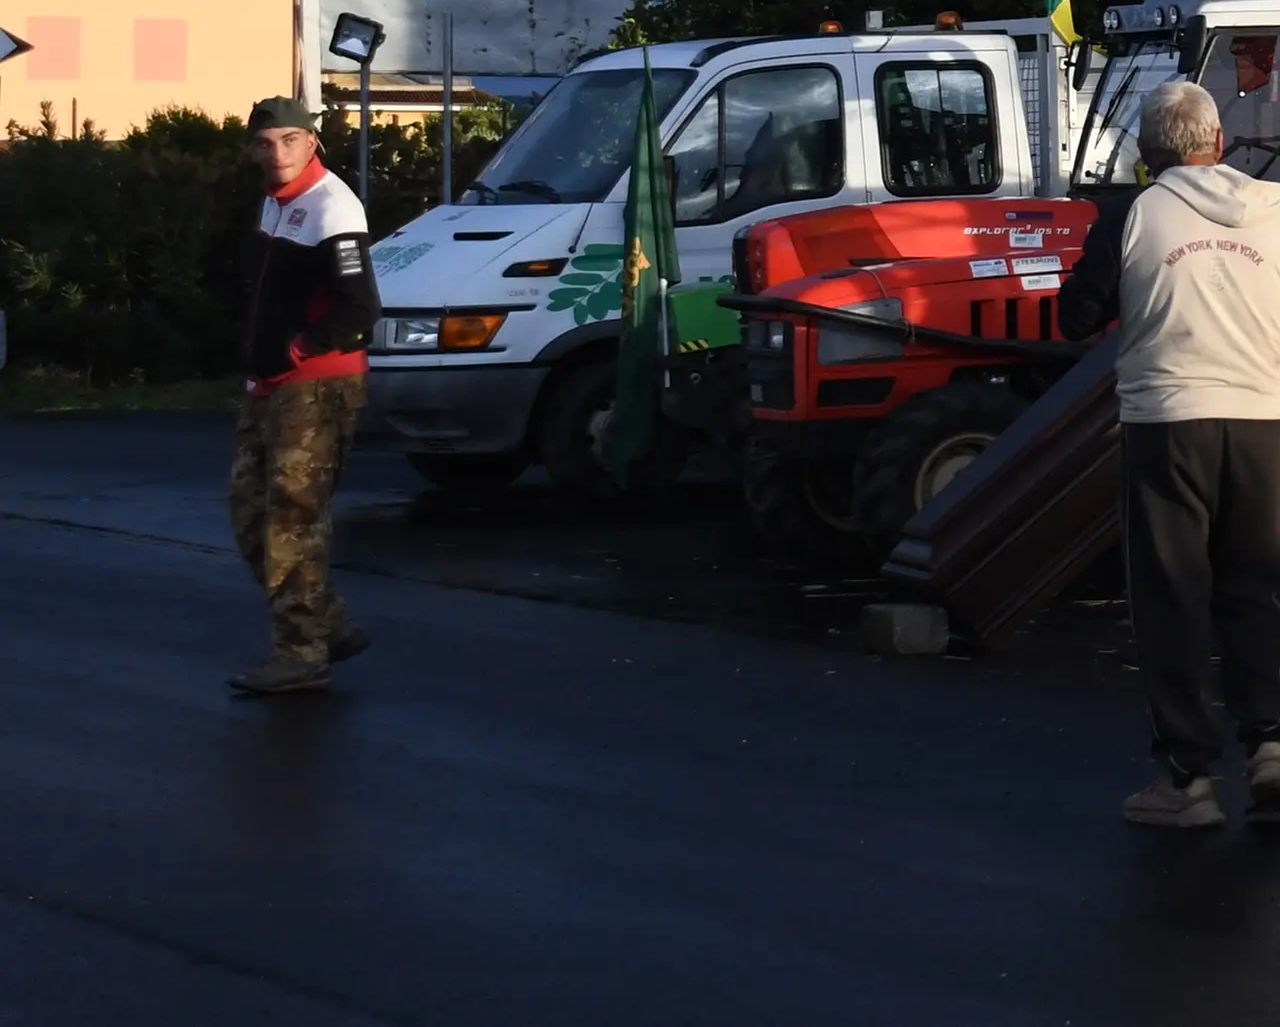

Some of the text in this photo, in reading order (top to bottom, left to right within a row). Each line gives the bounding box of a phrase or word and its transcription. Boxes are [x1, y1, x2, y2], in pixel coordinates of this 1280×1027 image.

[1164, 239, 1265, 267] NEW YORK NEW YORK
